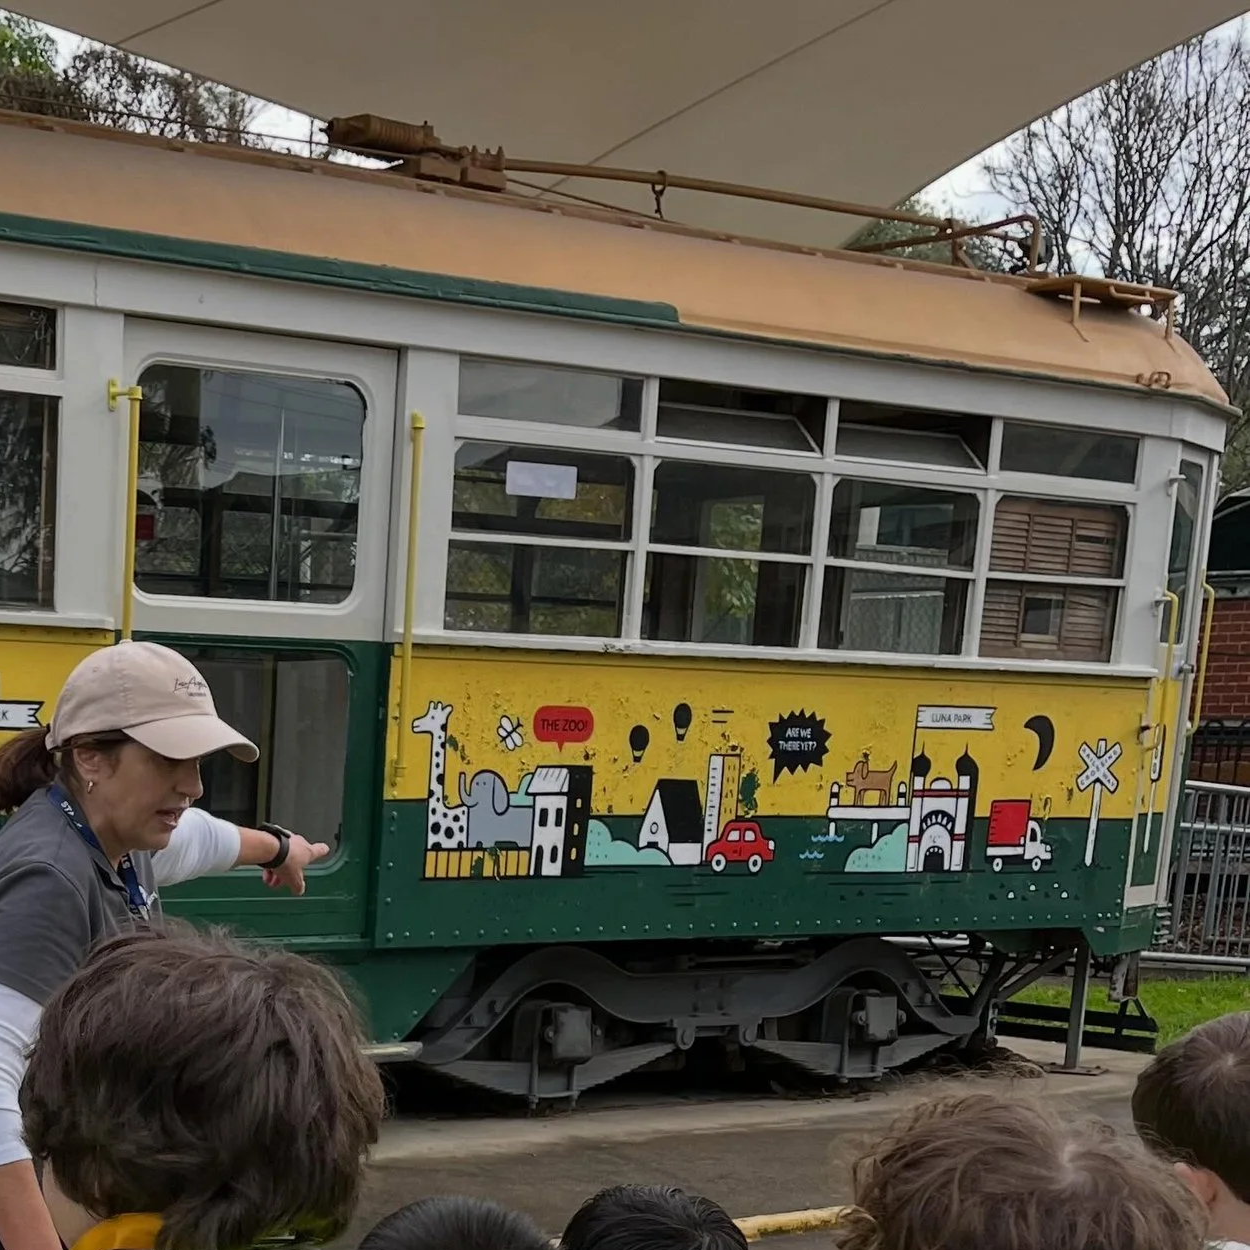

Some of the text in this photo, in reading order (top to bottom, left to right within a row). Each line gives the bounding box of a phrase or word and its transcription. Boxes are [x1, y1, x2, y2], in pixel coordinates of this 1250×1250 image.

[931, 713, 972, 724] LUNA PARK
[541, 718, 588, 732] THE ZOO!
[785, 727, 812, 739] ARE WE
[778, 740, 817, 752] THERE YET?
